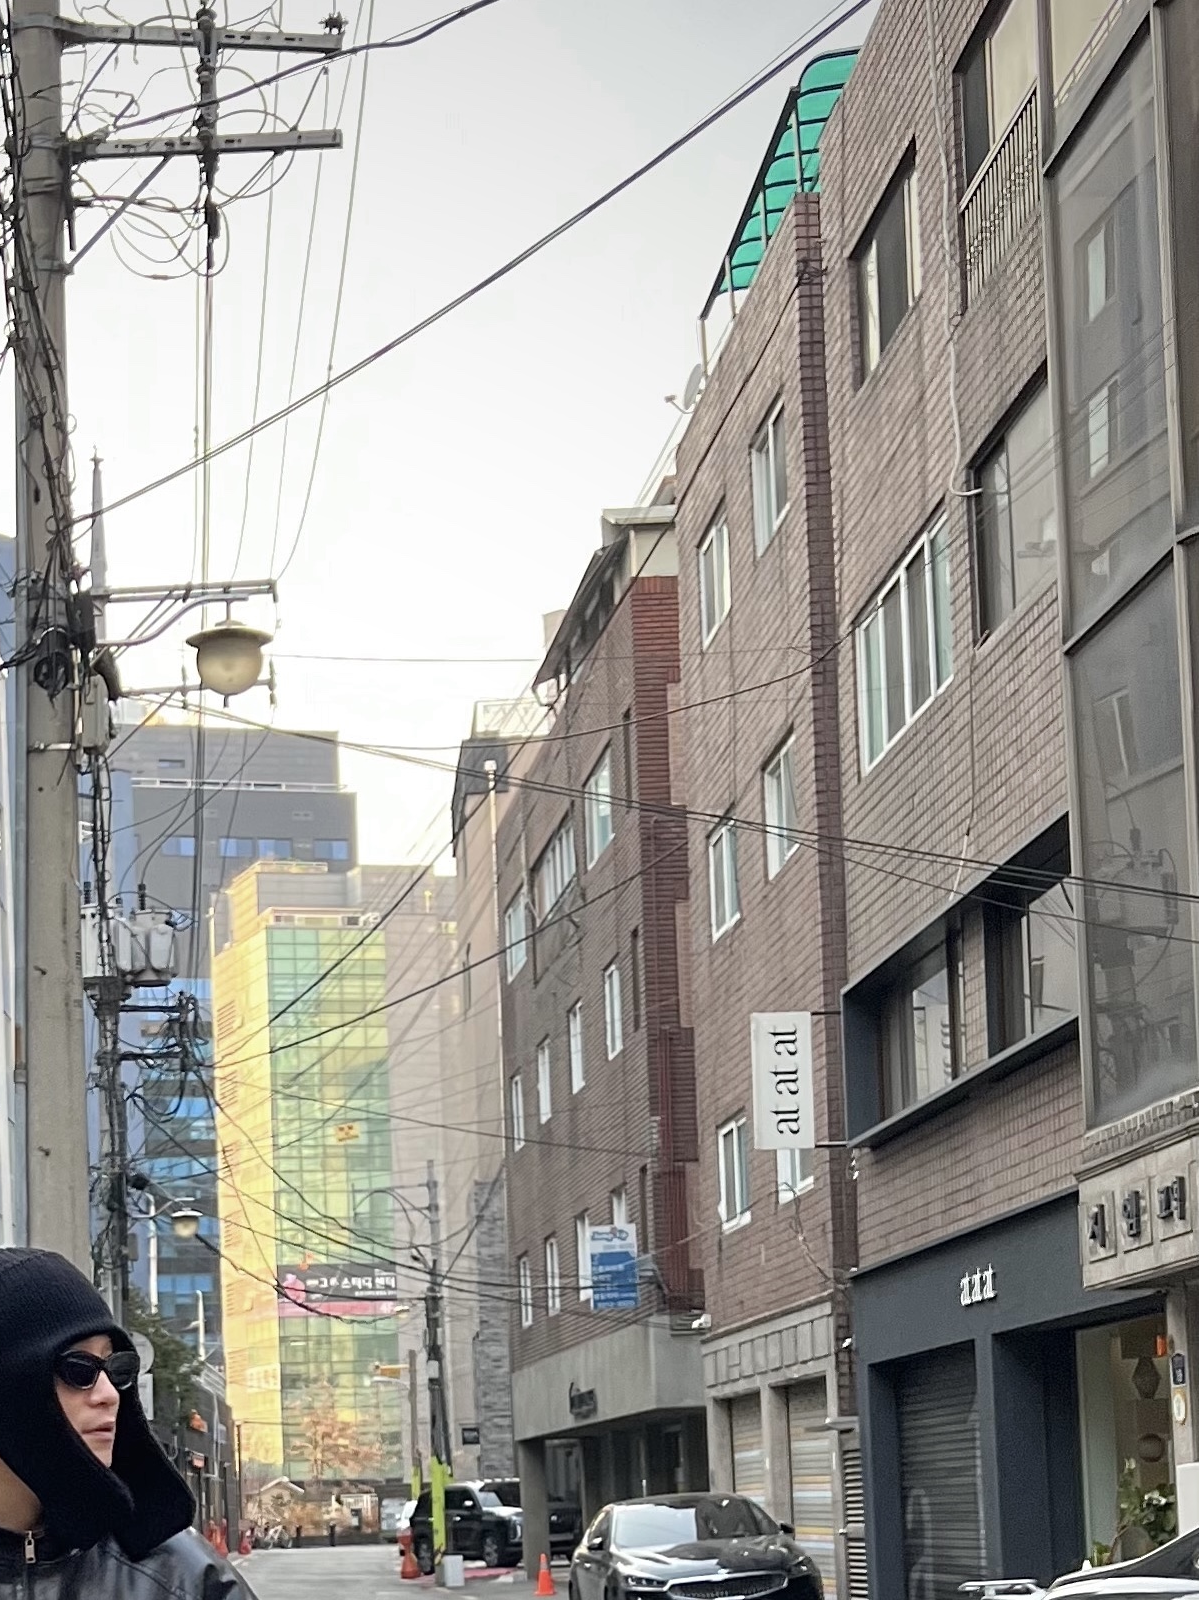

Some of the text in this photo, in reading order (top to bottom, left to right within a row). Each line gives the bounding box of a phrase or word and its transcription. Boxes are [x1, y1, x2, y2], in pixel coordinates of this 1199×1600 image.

[767, 1023, 800, 1135] at at at
